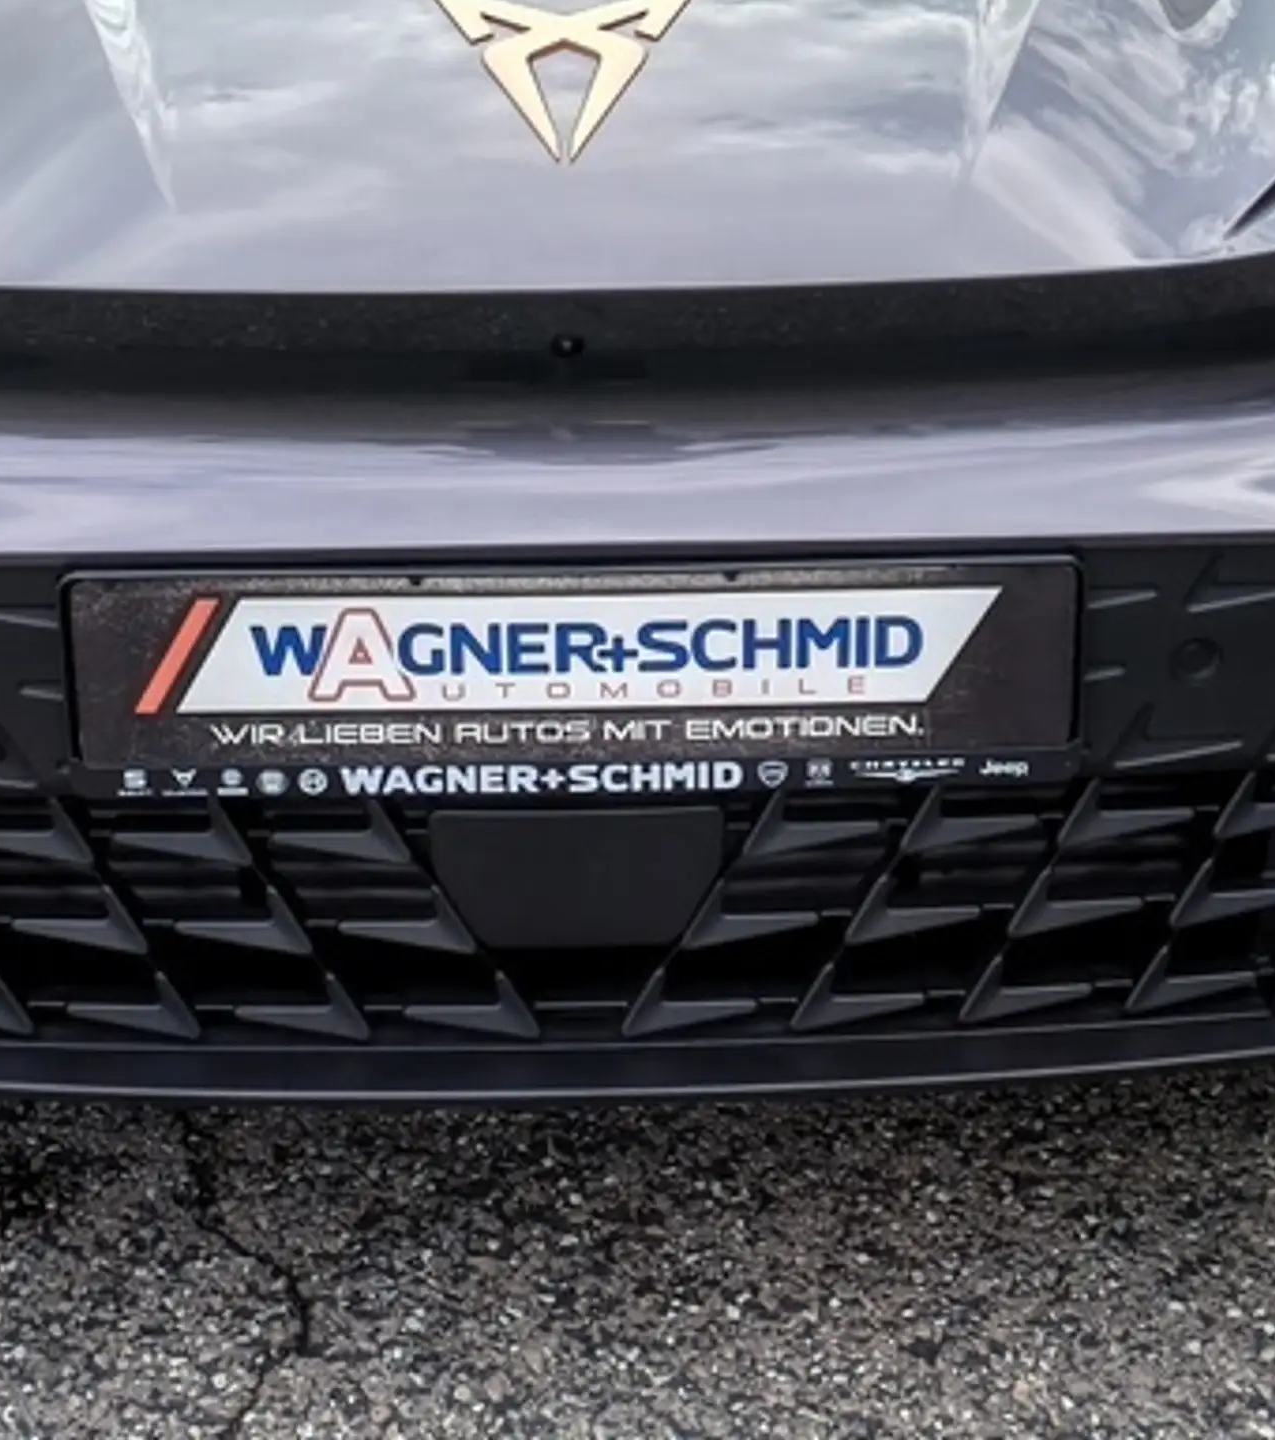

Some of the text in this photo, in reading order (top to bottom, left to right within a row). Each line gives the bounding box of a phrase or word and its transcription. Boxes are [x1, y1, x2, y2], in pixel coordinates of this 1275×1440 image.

[210, 721, 288, 745] WIR
[297, 720, 442, 745] LIEBEN
[453, 718, 591, 744] AUTOS
[603, 719, 673, 742] MIT
[341, 762, 743, 796] WAGNER+SCHMID
[979, 759, 1029, 777] Jeep
